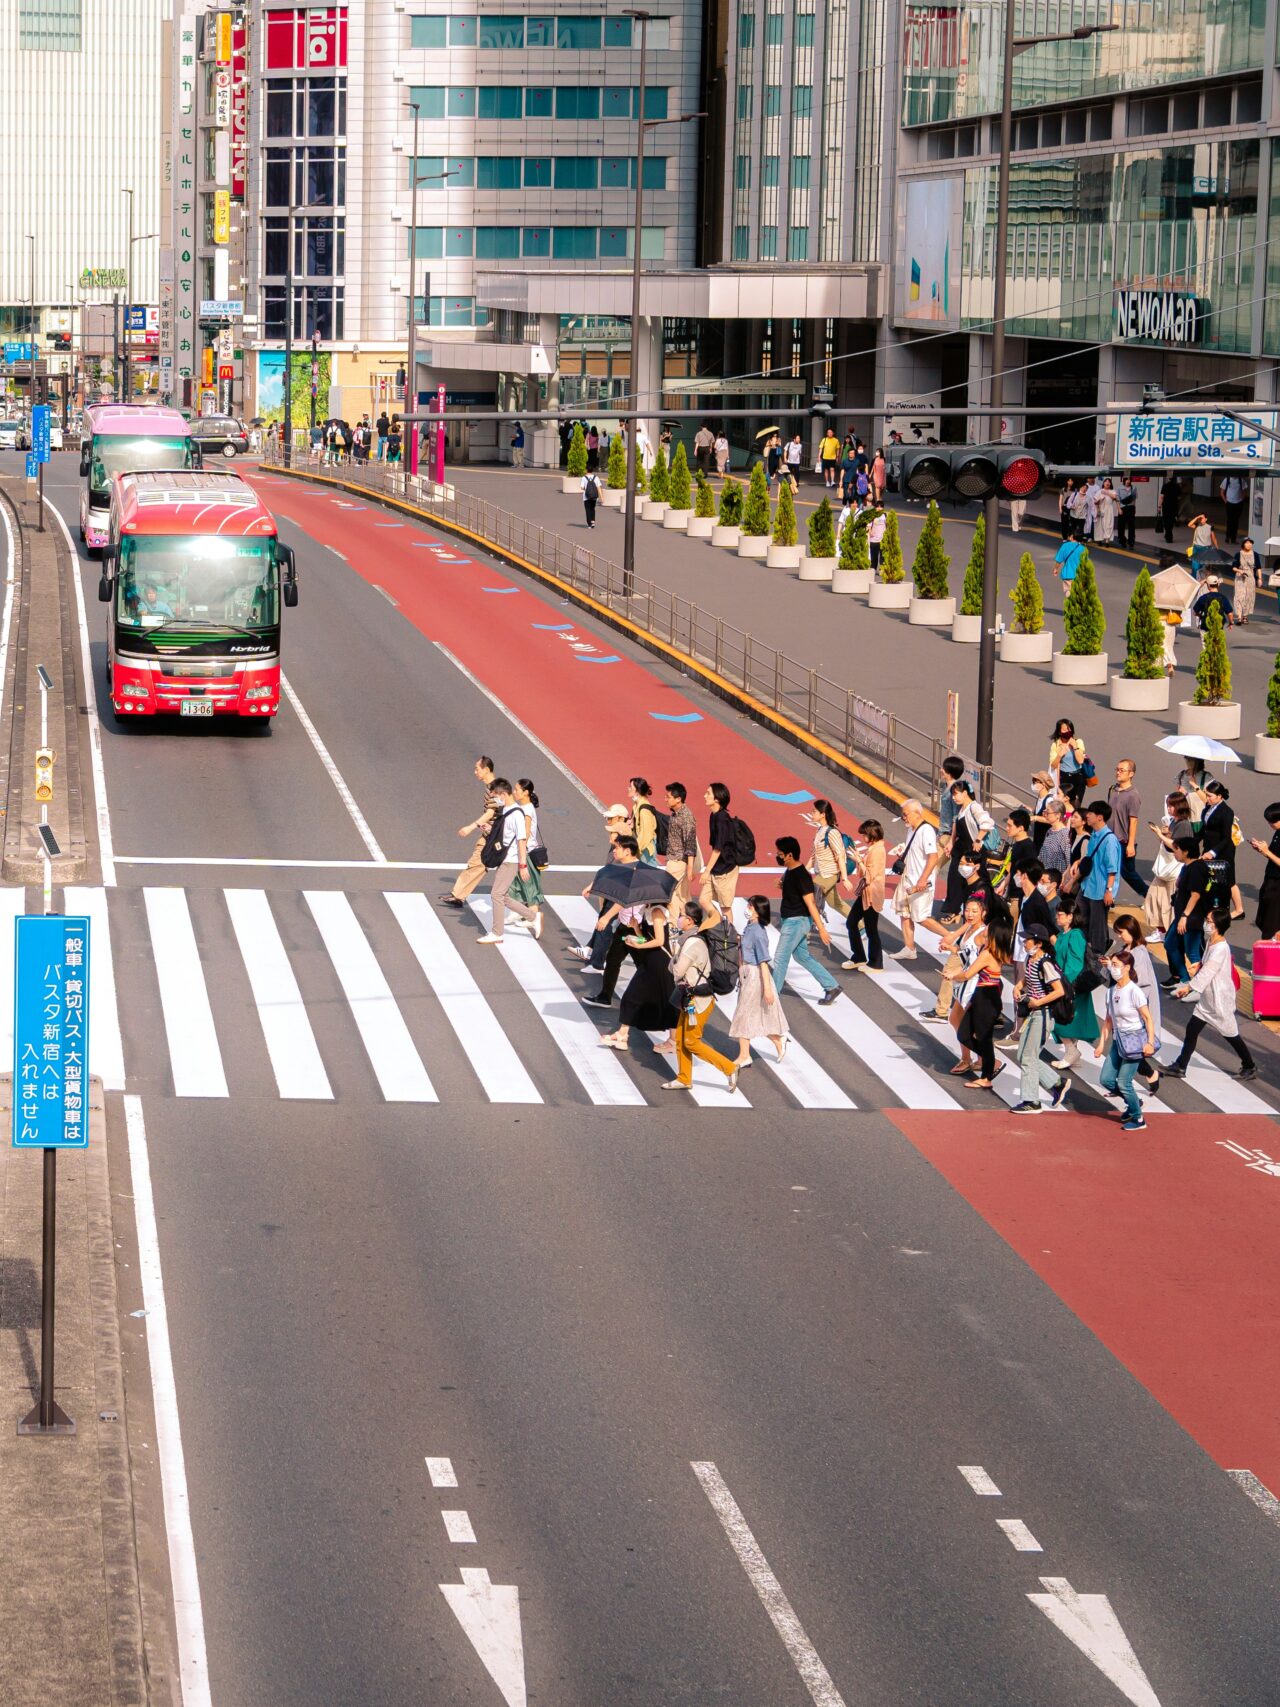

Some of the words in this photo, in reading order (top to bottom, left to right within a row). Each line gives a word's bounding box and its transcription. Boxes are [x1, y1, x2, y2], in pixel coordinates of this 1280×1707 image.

[79, 275, 128, 289] CINEMA
[1118, 291, 1196, 342] NEWoMan
[162, 358, 171, 367] P
[1128, 416, 1262, 442] 新宿駅南口
[1129, 443, 1191, 459] Shinjuku
[1198, 444, 1224, 459] Sta.
[1247, 445, 1261, 459] S.
[42, 964, 62, 1100] バスタ新宿へは
[63, 926, 84, 1139] 一般車・貸切バス・大型貨物車は
[21, 1044, 39, 1139] 入れません
